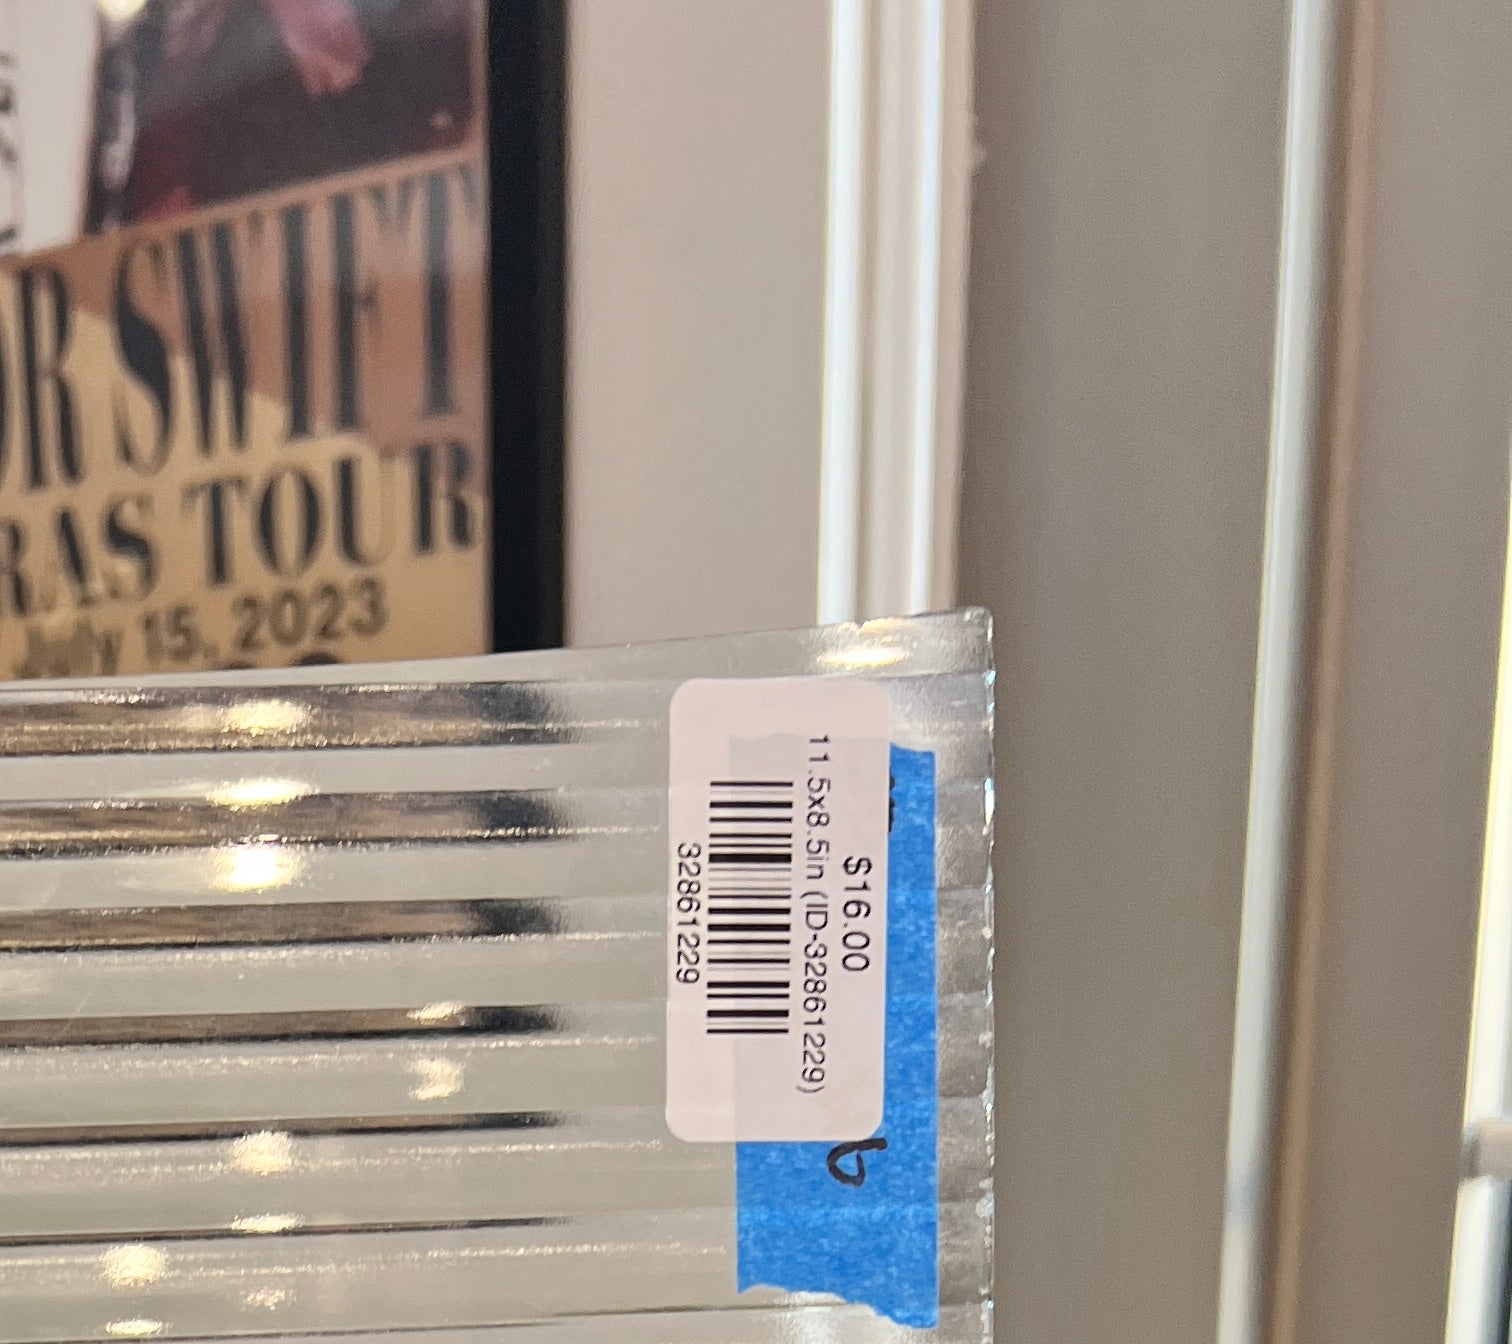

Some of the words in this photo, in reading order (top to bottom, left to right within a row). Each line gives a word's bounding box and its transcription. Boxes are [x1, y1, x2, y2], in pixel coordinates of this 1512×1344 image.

[110, 164, 482, 478] SWIFT
[182, 440, 480, 588] TOUR
[230, 577, 387, 652] 2023
[805, 734, 831, 881] 11.5x8.5in
[676, 842, 702, 984] 32861229
[842, 856, 873, 973] $16.00
[796, 890, 829, 1094] (ID-32861229)
